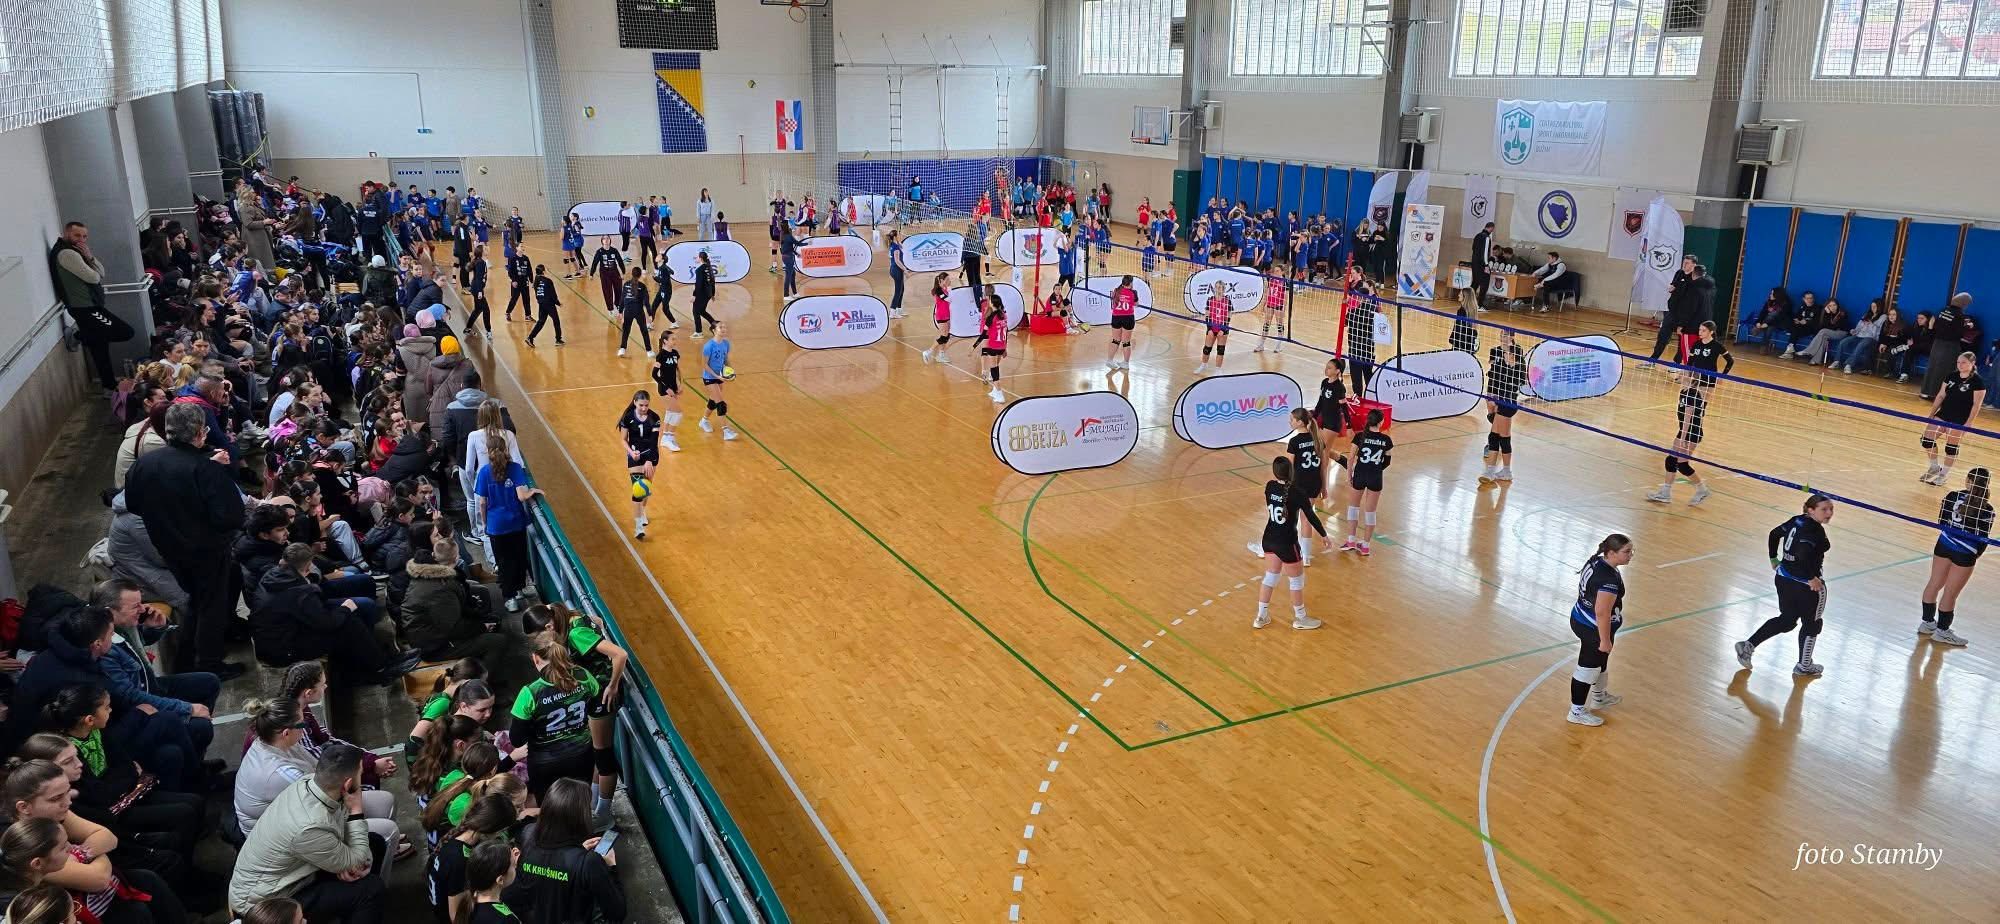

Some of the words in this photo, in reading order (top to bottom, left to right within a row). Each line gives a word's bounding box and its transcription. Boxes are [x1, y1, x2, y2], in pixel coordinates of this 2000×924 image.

[912, 249, 958, 258] E-GRADNJA
[1115, 302, 1130, 310] 20
[638, 424, 645, 437] 1
[1032, 423, 1058, 432] BUTIK
[1032, 430, 1068, 449] BEJZA
[1301, 451, 1321, 469] 33
[1359, 447, 1384, 465] 34
[1268, 504, 1286, 524] 16
[1784, 527, 1797, 551] 6
[542, 696, 553, 705] OK
[546, 701, 586, 731] 23
[523, 863, 531, 872] OK
